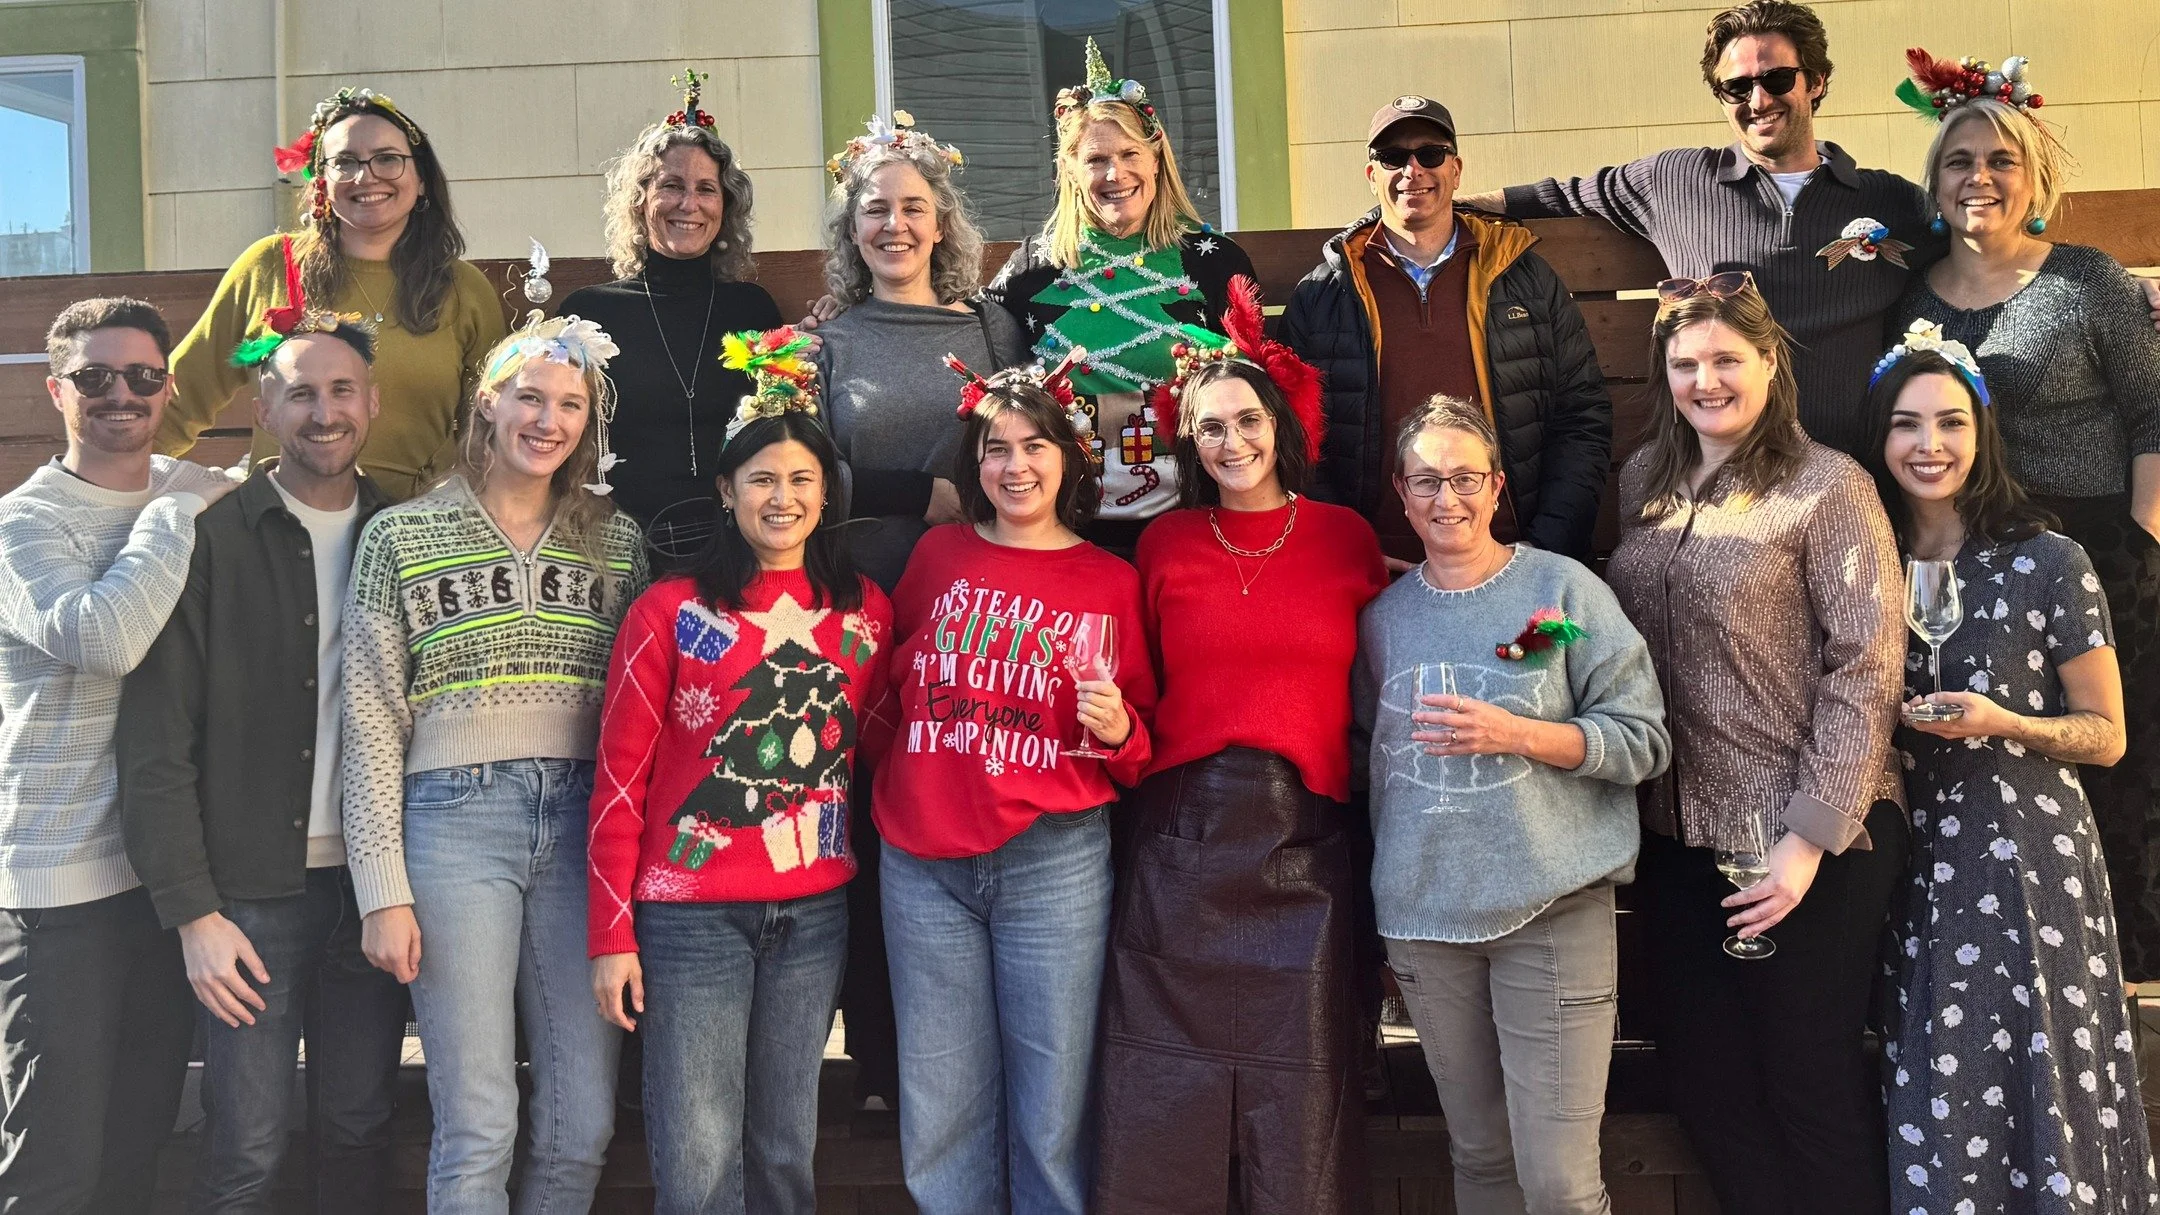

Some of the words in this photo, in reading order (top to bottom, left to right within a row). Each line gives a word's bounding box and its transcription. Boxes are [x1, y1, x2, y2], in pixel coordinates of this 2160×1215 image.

[360, 546, 374, 577] CHILL
[368, 516, 397, 544] STAY
[399, 515, 430, 526] CHILL
[432, 509, 461, 524] STAY
[930, 588, 1044, 624] INSTEAD
[935, 610, 1057, 668] GIFTS
[413, 675, 444, 695] STAY
[446, 669, 473, 684] CHILL
[476, 663, 503, 680] STAY
[506, 660, 530, 675] CHILL
[533, 661, 560, 675] STAY
[588, 666, 607, 681] STA
[919, 653, 958, 687] I'M
[967, 657, 1063, 709] GIVING
[925, 679, 1043, 743] Everyone
[907, 720, 943, 753] MY
[954, 720, 1060, 770] OPINION
